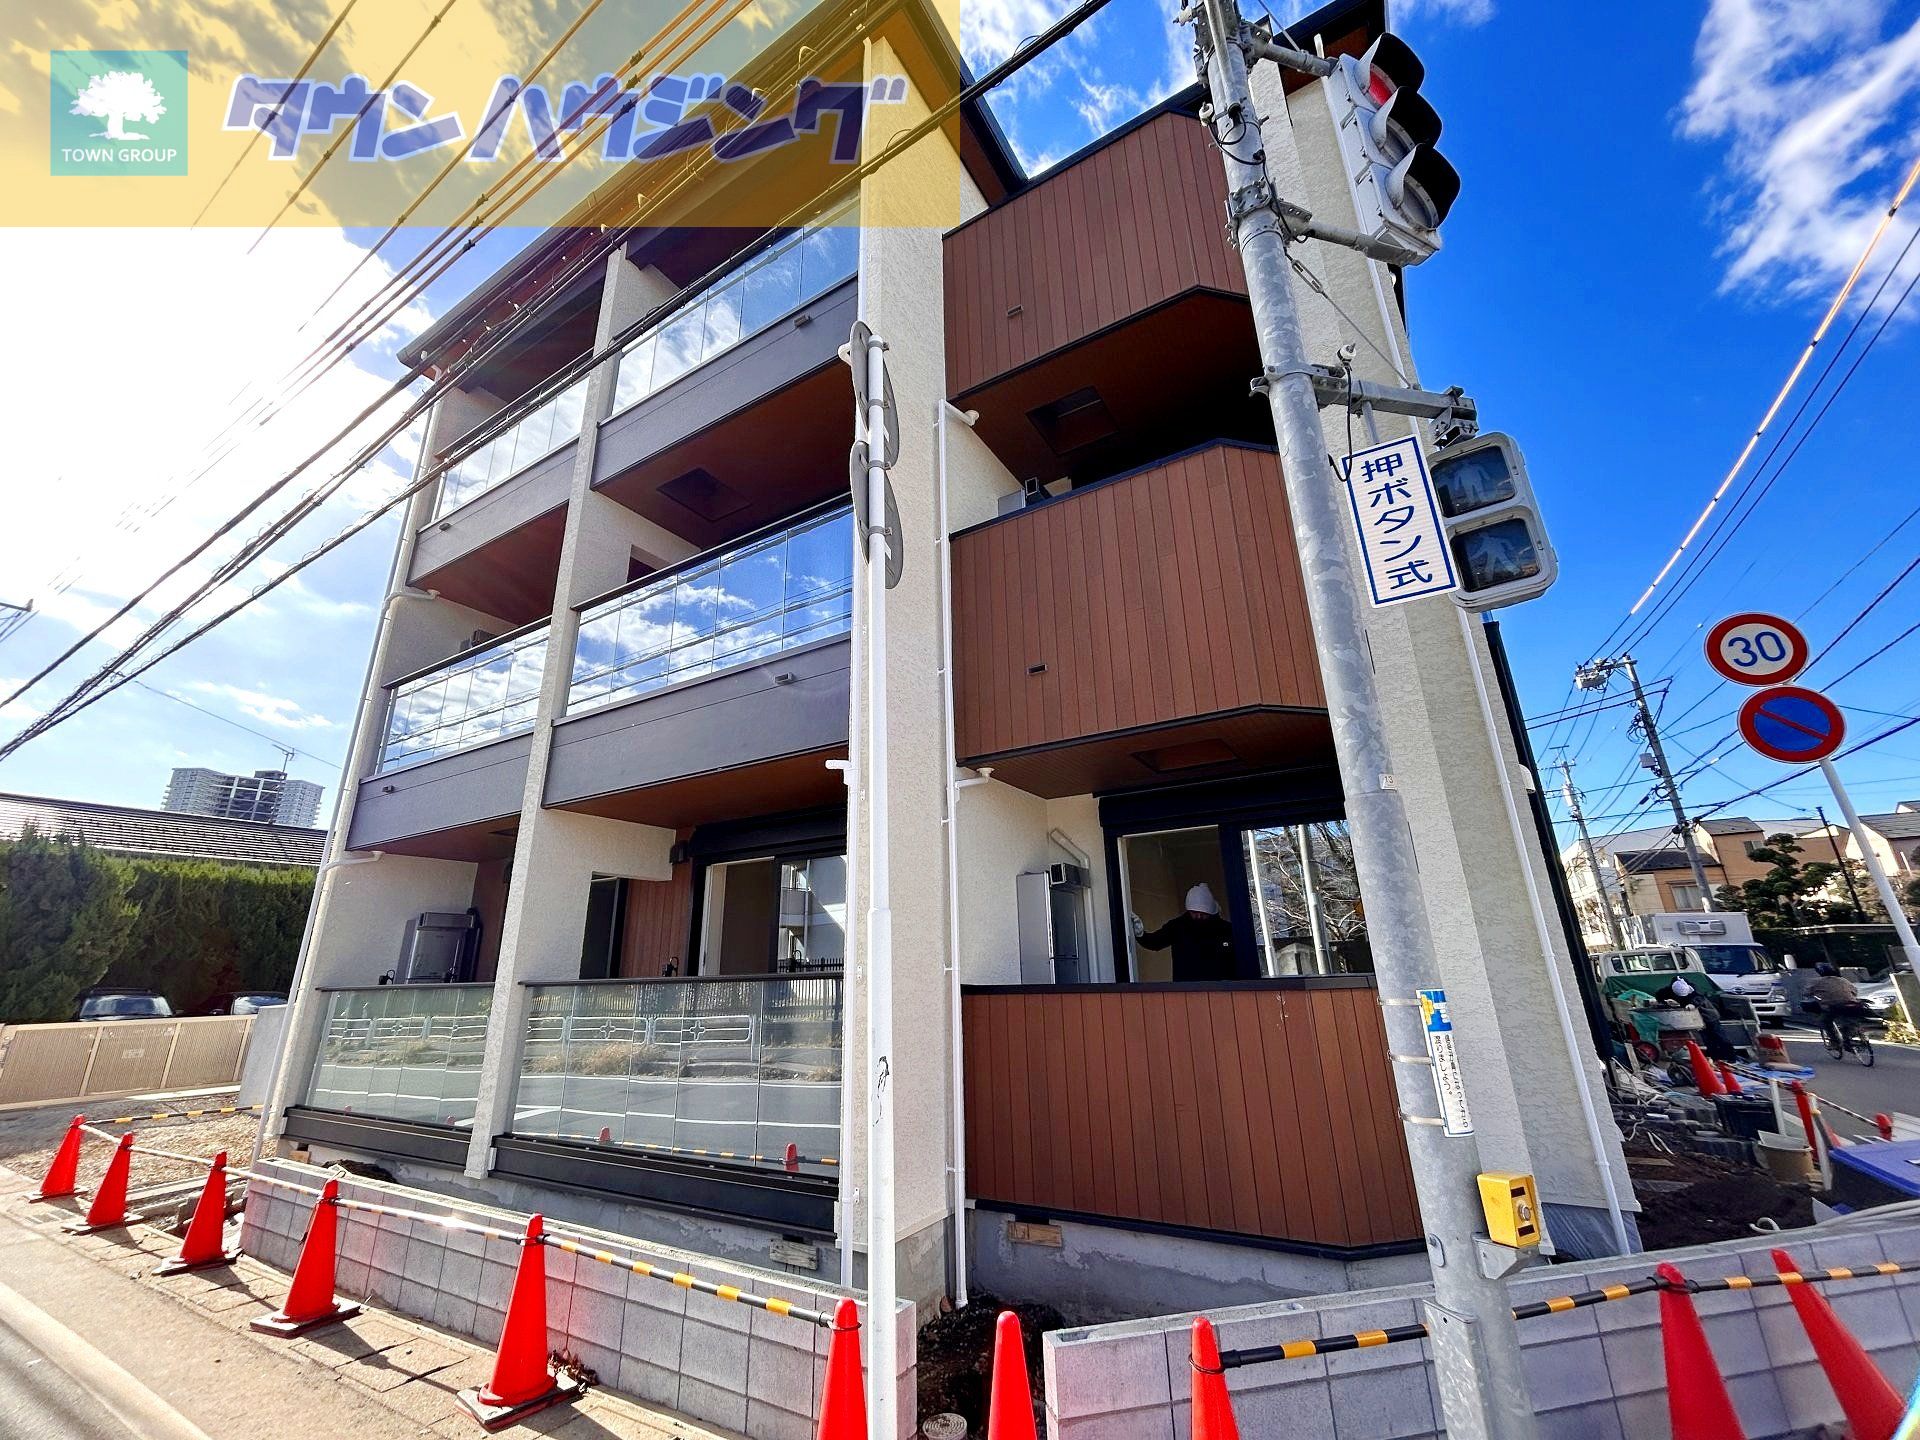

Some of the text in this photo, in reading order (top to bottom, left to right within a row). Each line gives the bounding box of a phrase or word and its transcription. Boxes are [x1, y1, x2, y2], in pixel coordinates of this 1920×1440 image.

[1361, 452, 1433, 590] 押ボタン式
[1728, 631, 1786, 667] 30
